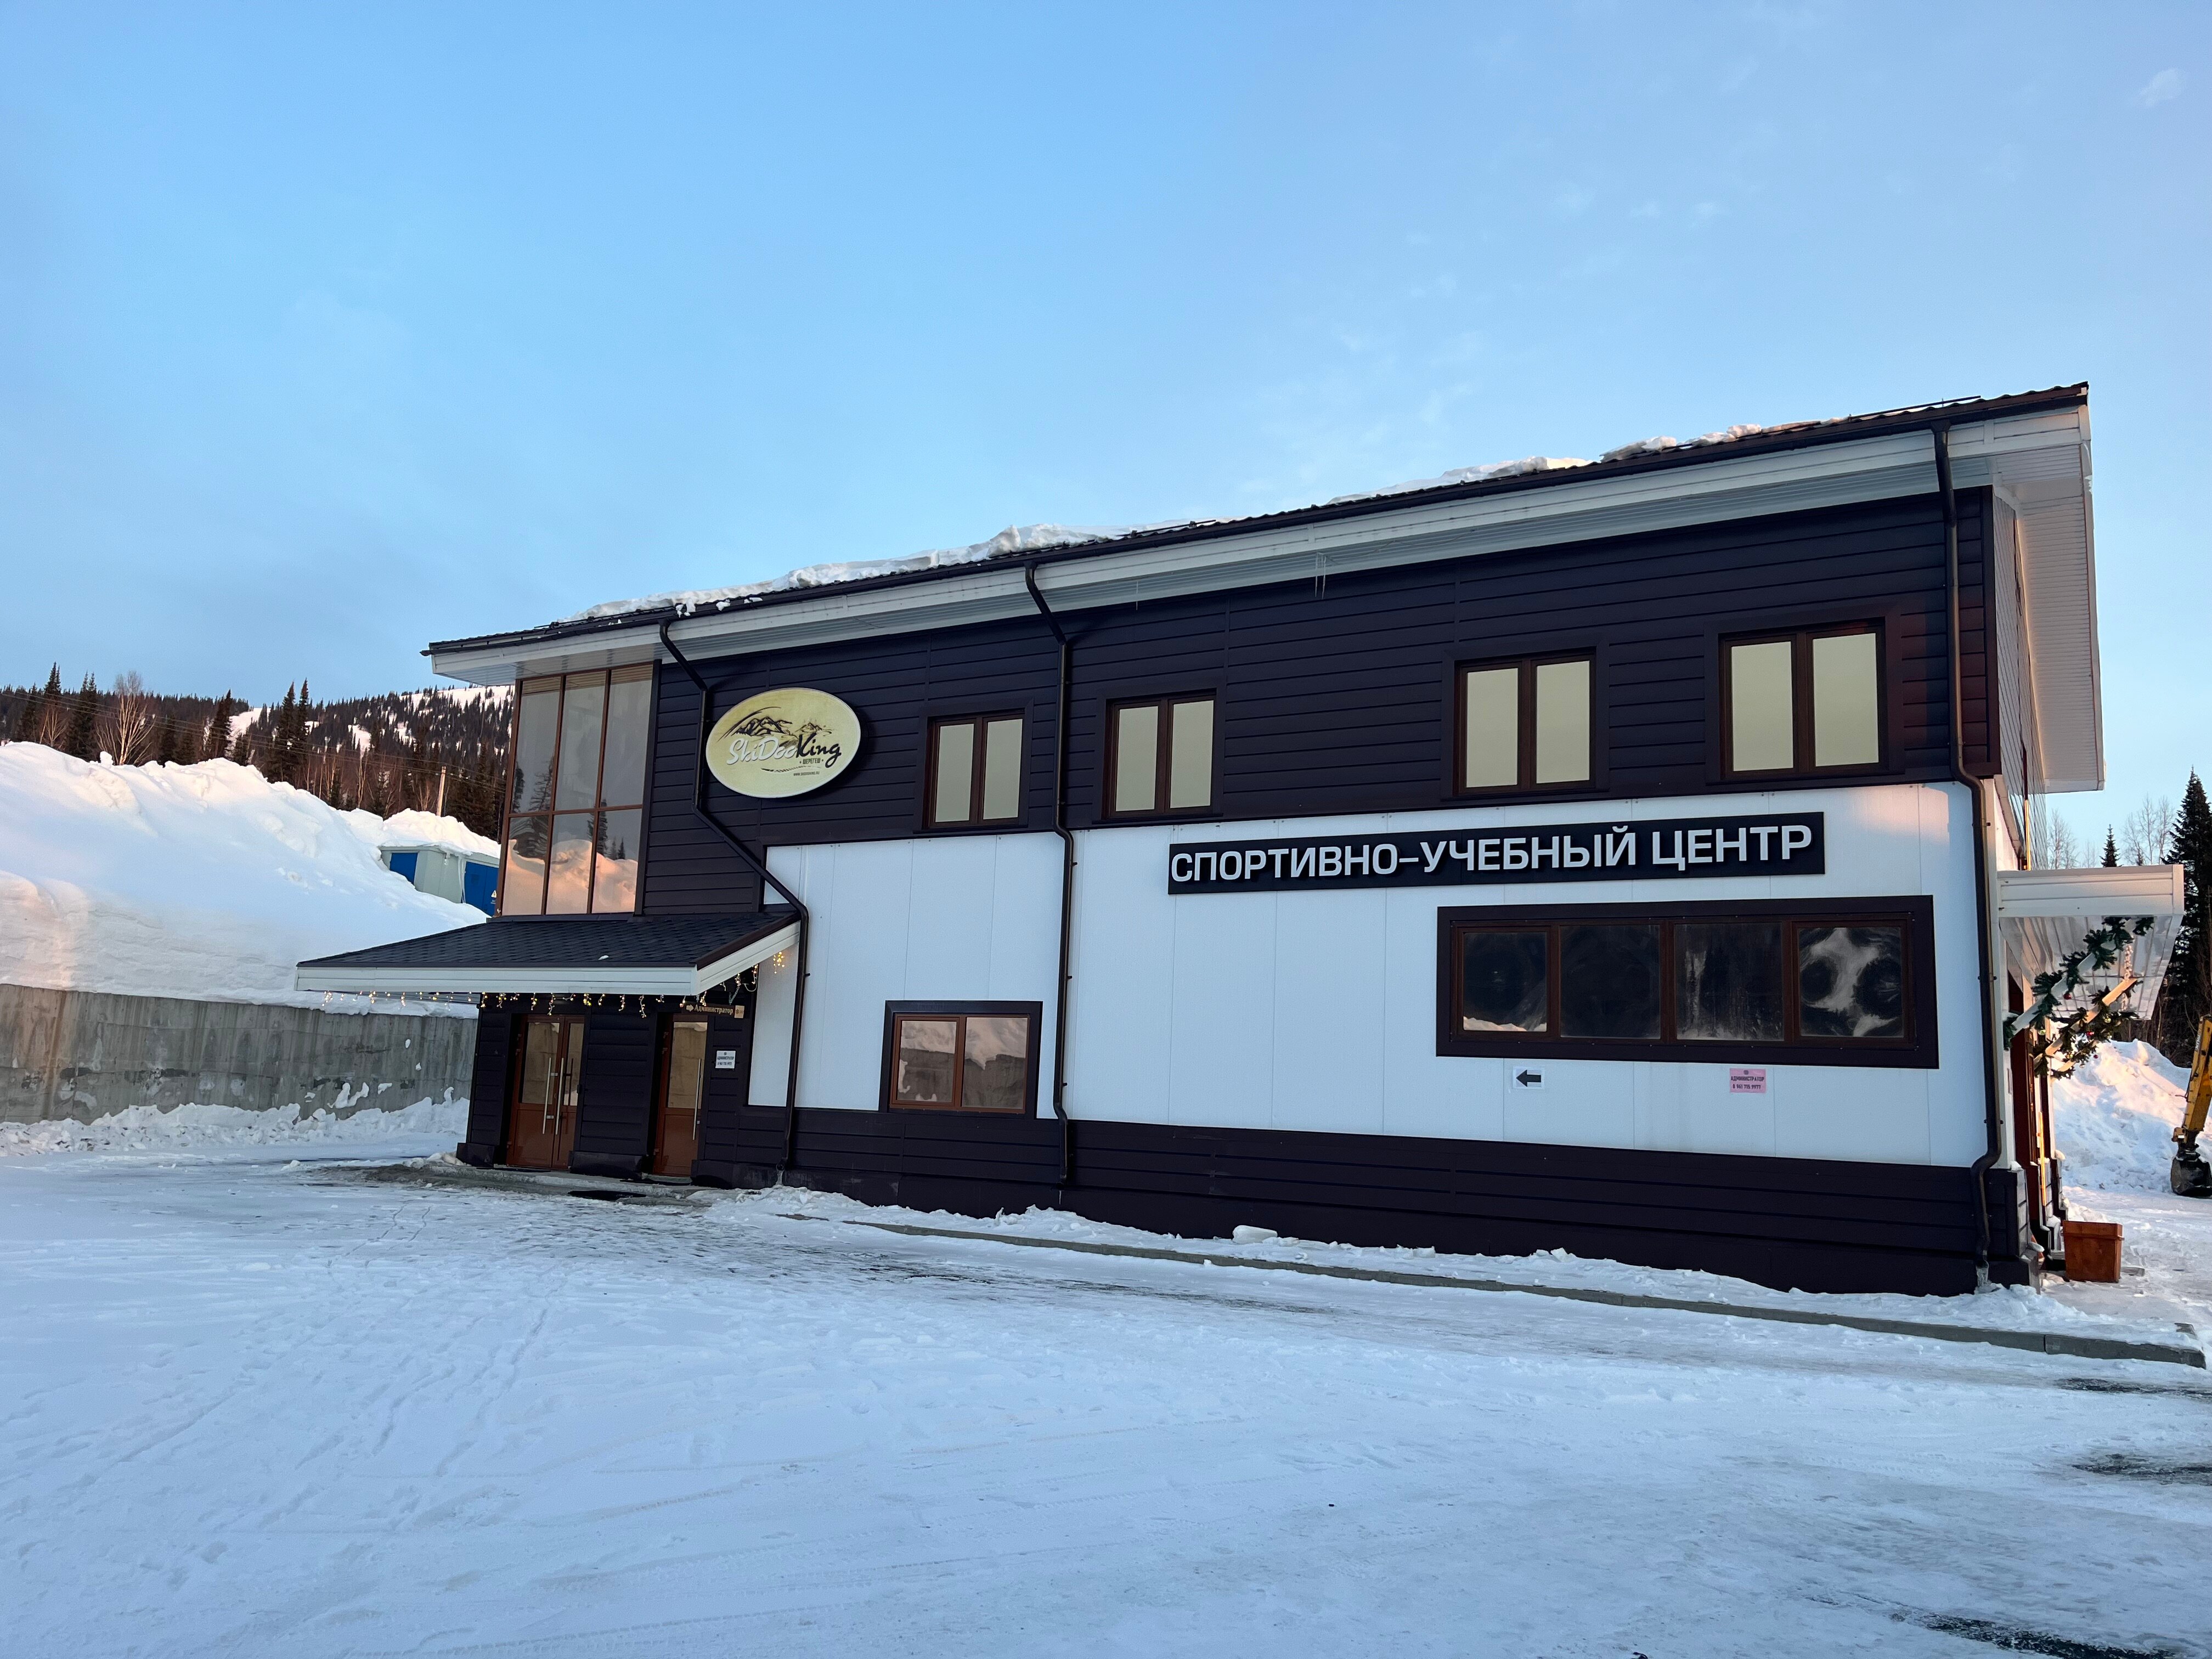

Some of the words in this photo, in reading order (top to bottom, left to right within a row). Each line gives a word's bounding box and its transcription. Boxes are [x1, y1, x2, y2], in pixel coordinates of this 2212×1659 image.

[1171, 825, 1636, 882] СПОРТИВНО-УЧЕБНЫЙ
[1652, 825, 1812, 871] ЦЕНТР
[694, 1004, 733, 1015] Администратор
